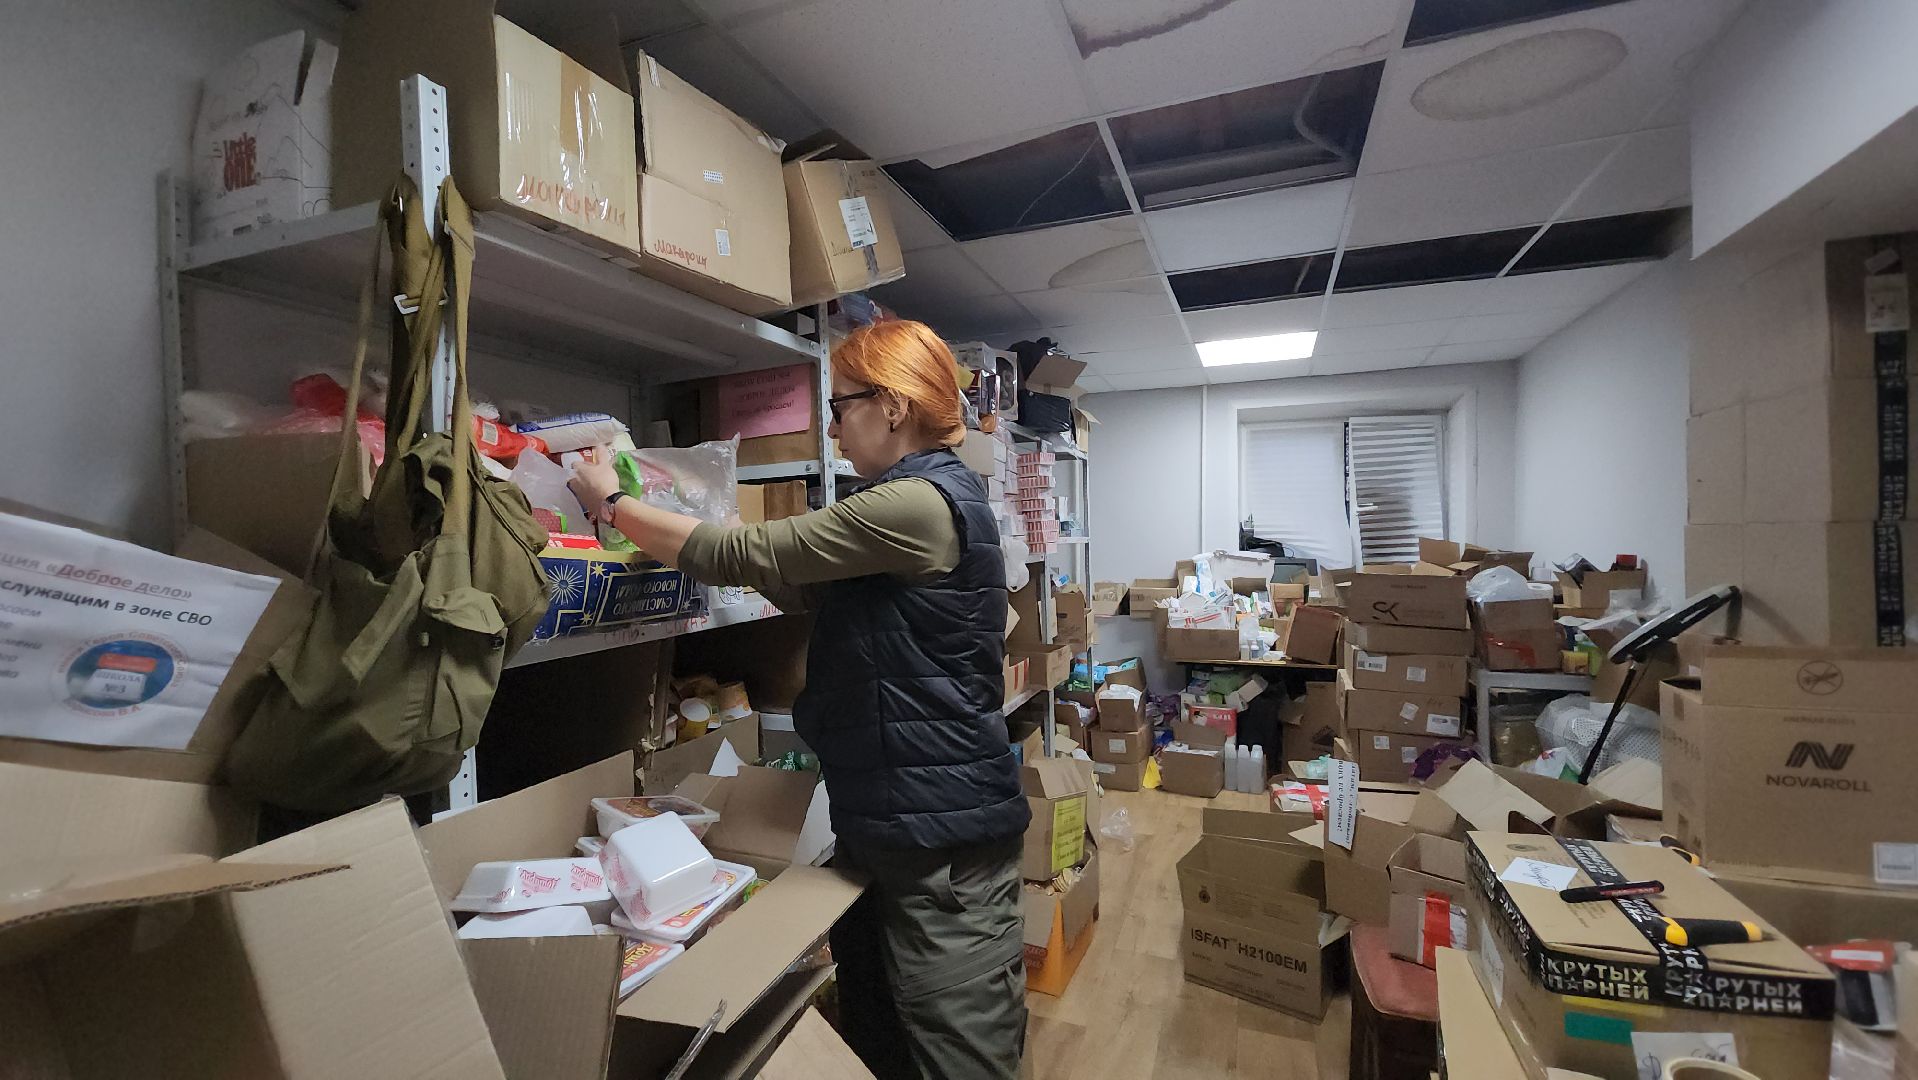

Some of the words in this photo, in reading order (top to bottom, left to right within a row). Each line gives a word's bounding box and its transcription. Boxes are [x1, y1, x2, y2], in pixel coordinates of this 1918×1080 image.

[0, 553, 40, 569] ция
[133, 582, 193, 599] дело»
[0, 580, 111, 609] служащим
[114, 602, 126, 611] в
[129, 604, 173, 620] зоне
[177, 611, 213, 626] СВО
[1766, 774, 1873, 792] NOVAROLL
[1191, 928, 1230, 949] ISFAT
[1239, 942, 1307, 974] H2100EM
[1547, 957, 1647, 984] КРУТЫХ
